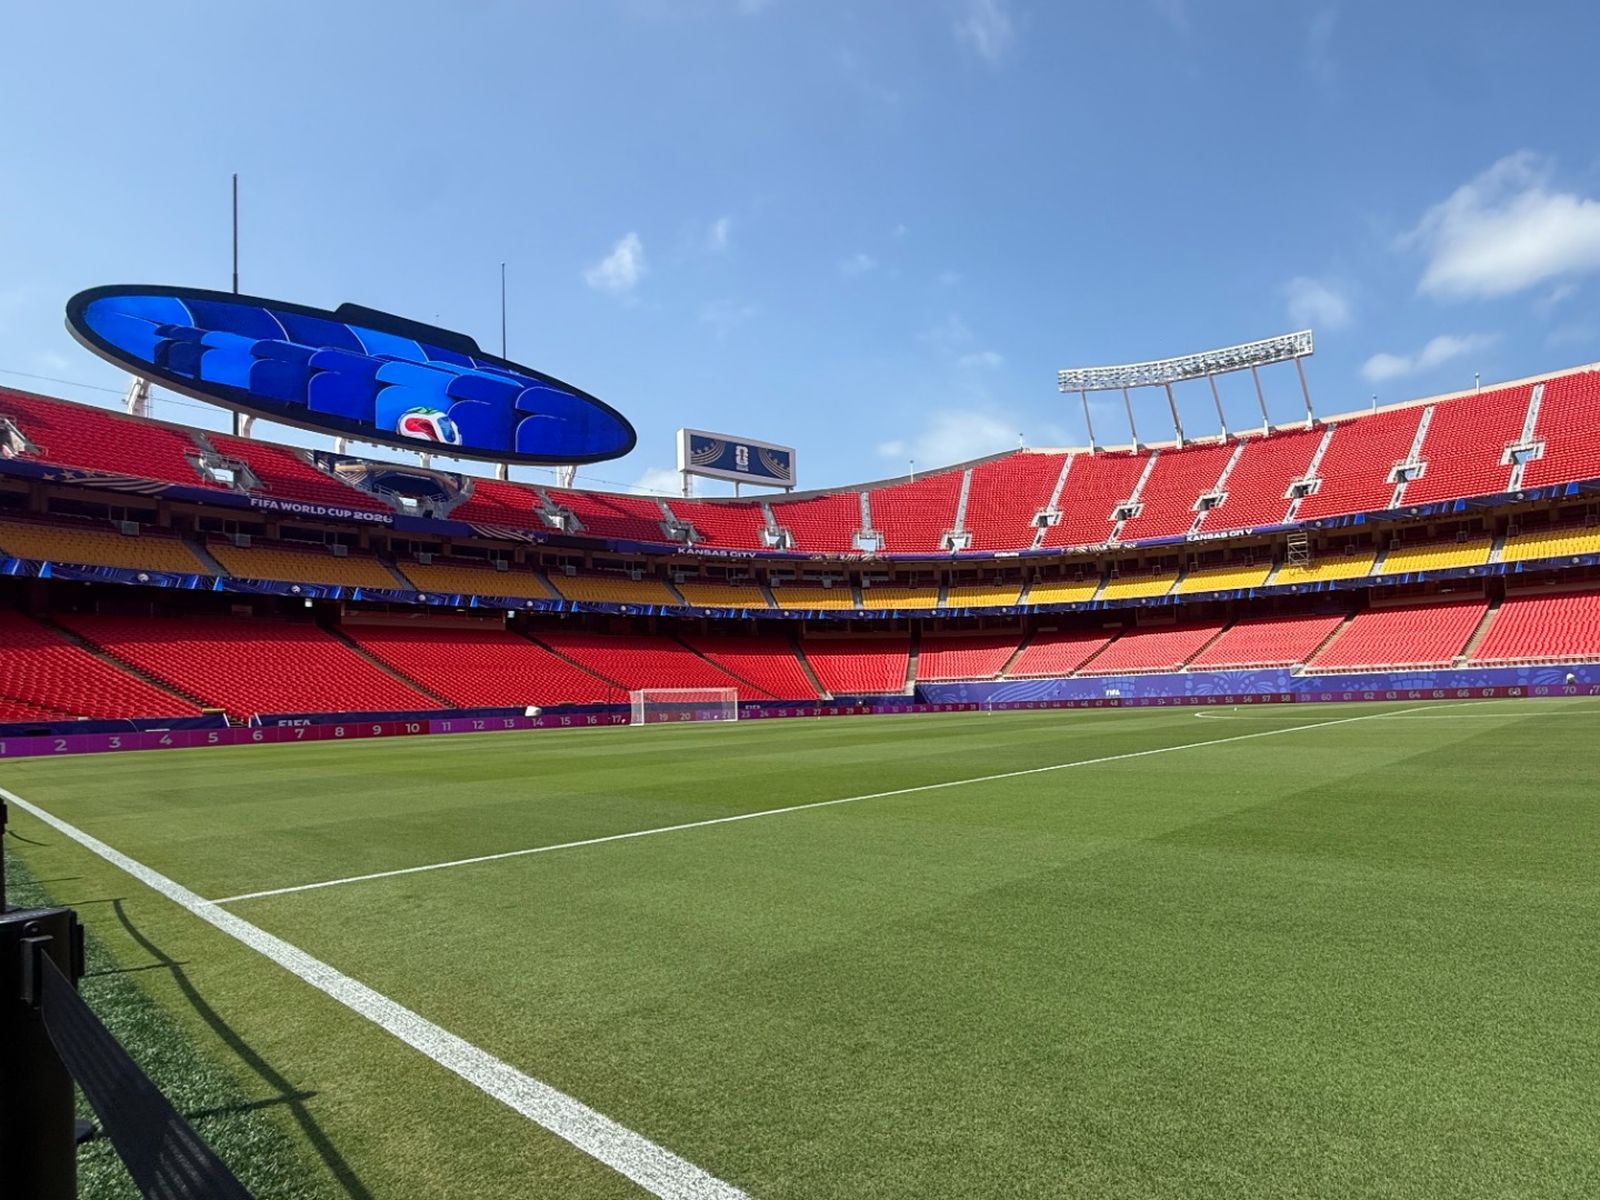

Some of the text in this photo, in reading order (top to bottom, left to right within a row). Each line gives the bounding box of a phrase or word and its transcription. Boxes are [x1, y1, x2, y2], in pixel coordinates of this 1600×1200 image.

[250, 498, 394, 524] FIFA WORLD CUP 2026
[678, 548, 727, 557] KANSAS
[54, 739, 67, 751] 2
[109, 736, 121, 748] 3
[160, 734, 173, 745] 4
[208, 732, 218, 743] 5
[253, 730, 263, 740] 6
[295, 728, 304, 738] 7
[335, 727, 344, 737] 8
[372, 725, 382, 735] 9
[406, 724, 420, 733] 10
[442, 722, 451, 731] 11
[472, 720, 485, 730] 12
[504, 720, 514, 728] 13
[532, 718, 544, 727] 14
[560, 717, 571, 726] 15
[586, 716, 597, 724] 16
[612, 715, 621, 723] 17
[1457, 689, 1470, 697] 66
[1482, 688, 1494, 696] 67
[1535, 686, 1548, 694] 69
[1562, 686, 1576, 694] 70
